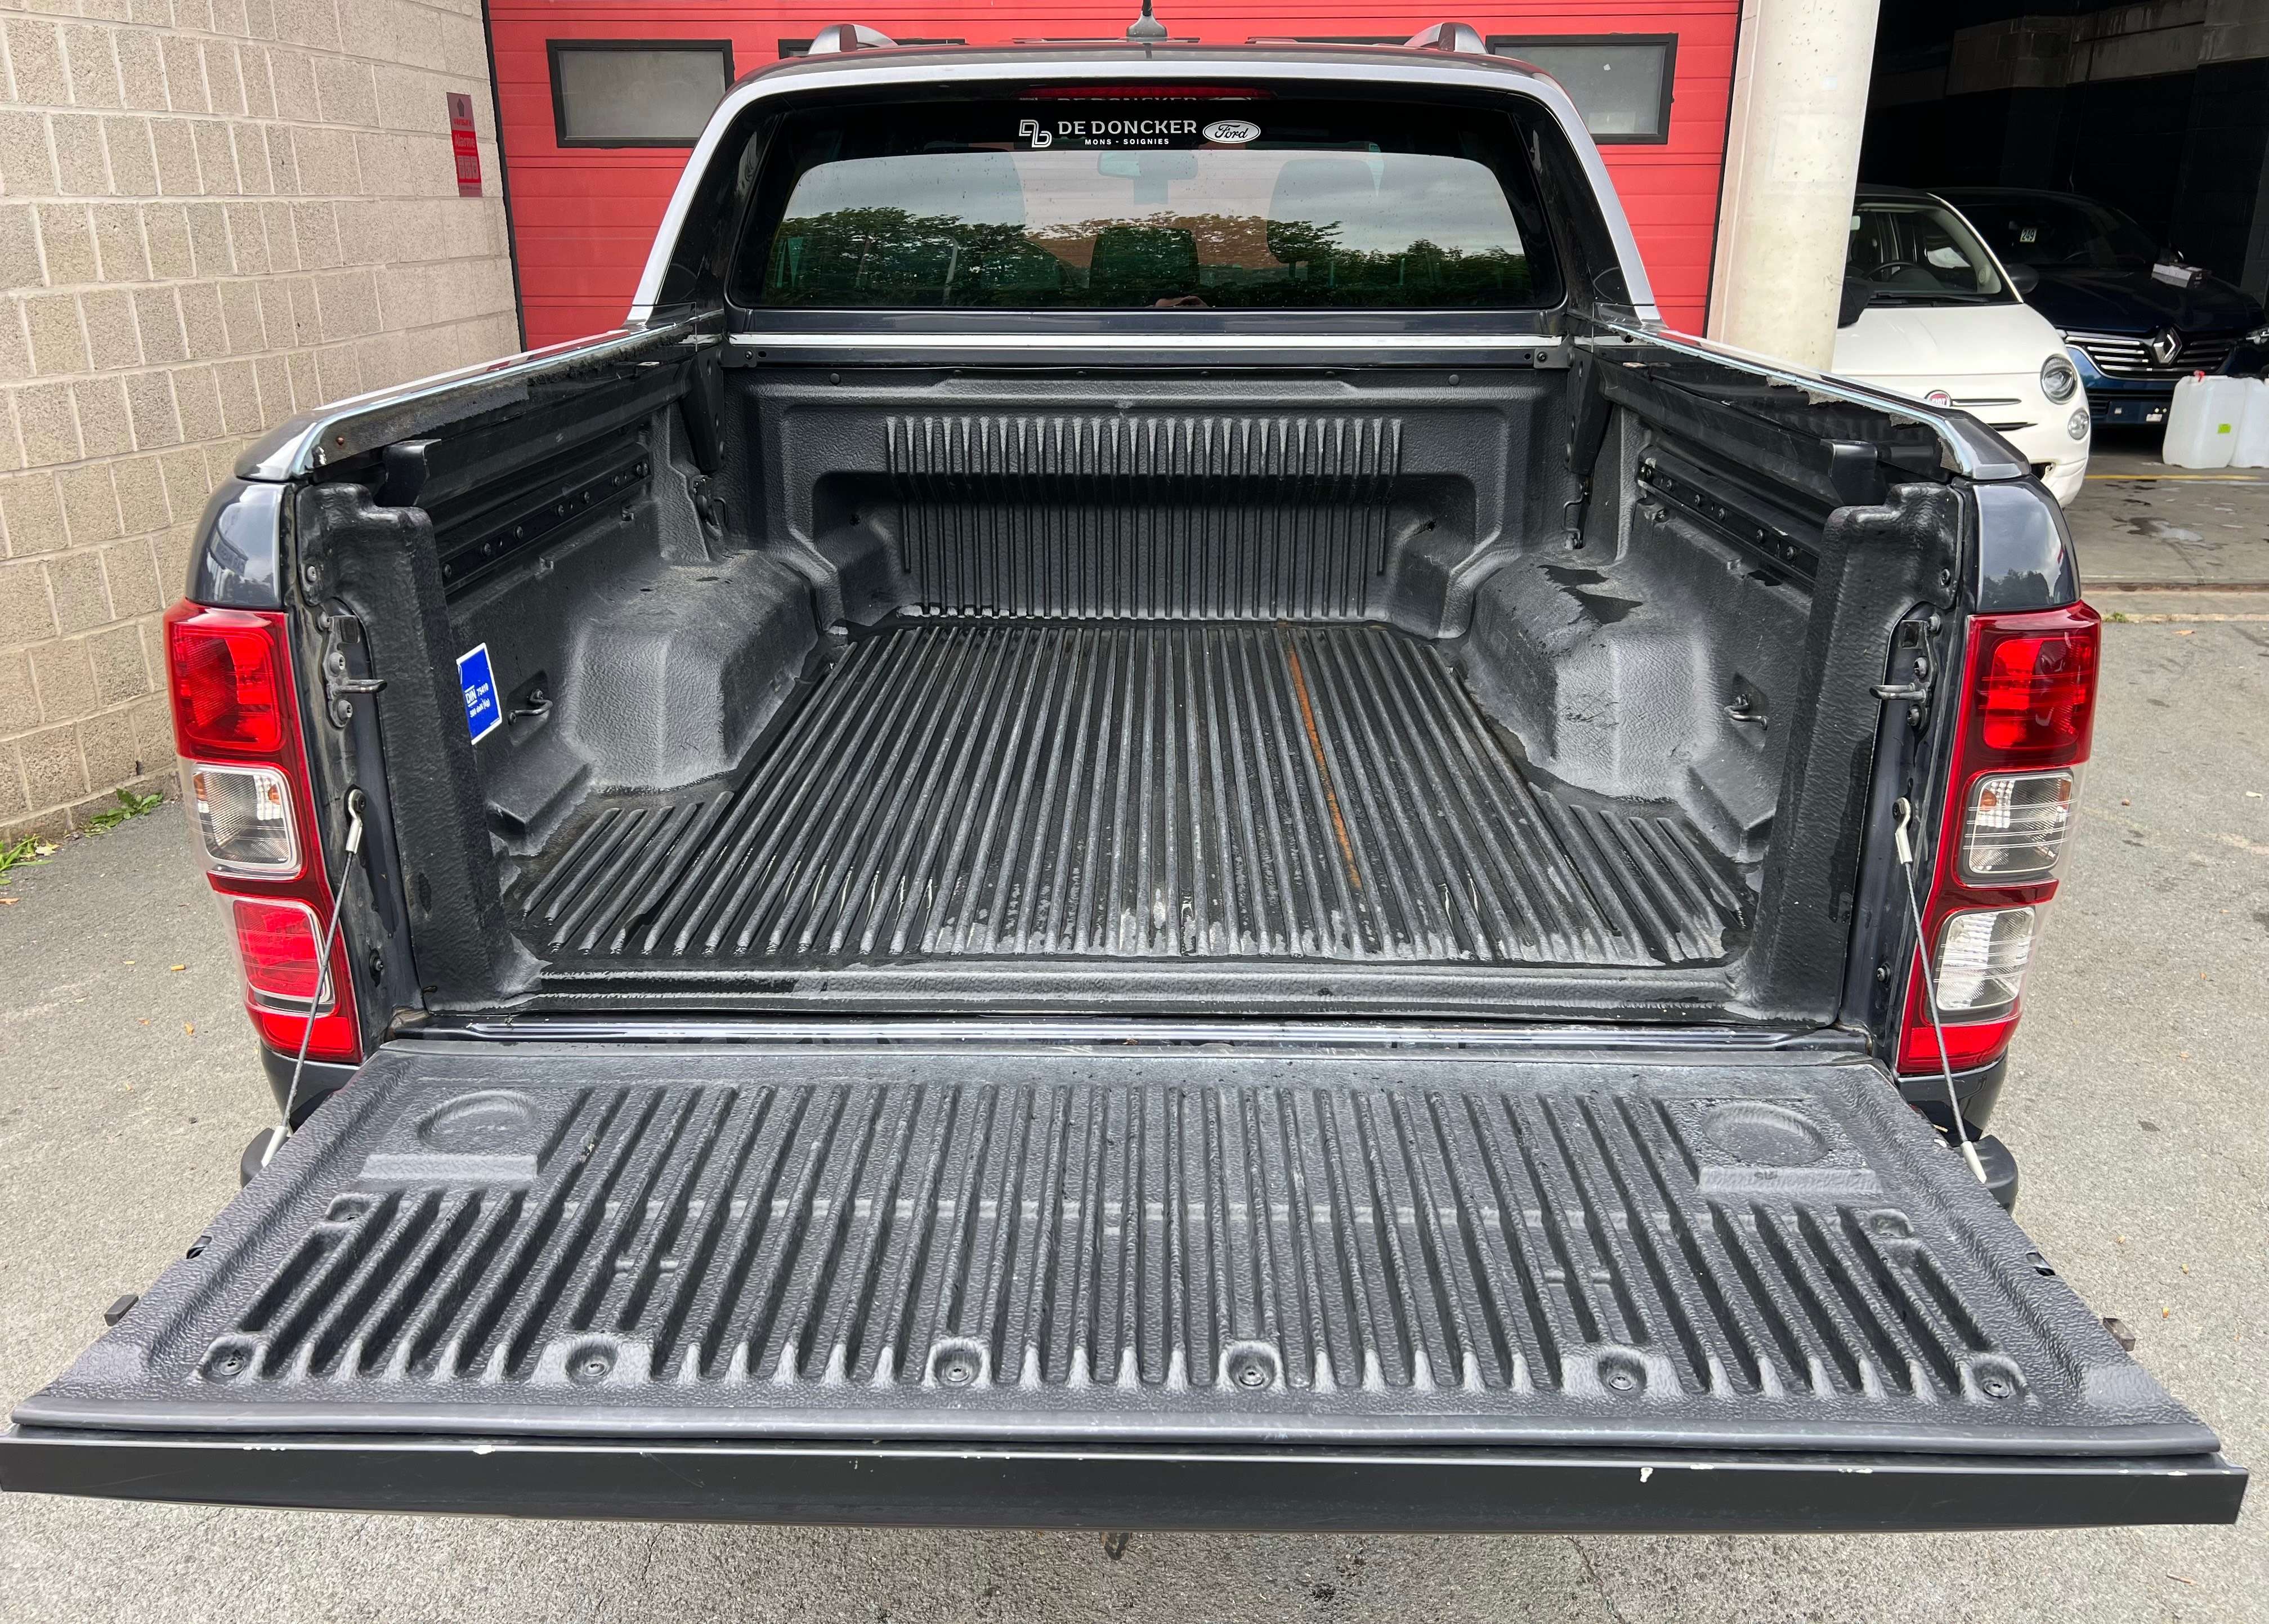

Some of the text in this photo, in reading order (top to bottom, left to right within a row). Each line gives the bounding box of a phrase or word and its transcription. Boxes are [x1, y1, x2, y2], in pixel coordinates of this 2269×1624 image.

[1058, 120, 1197, 135] DE DONCKER
[2021, 230, 2035, 241] 249
[465, 683, 489, 704] DIN 75410
